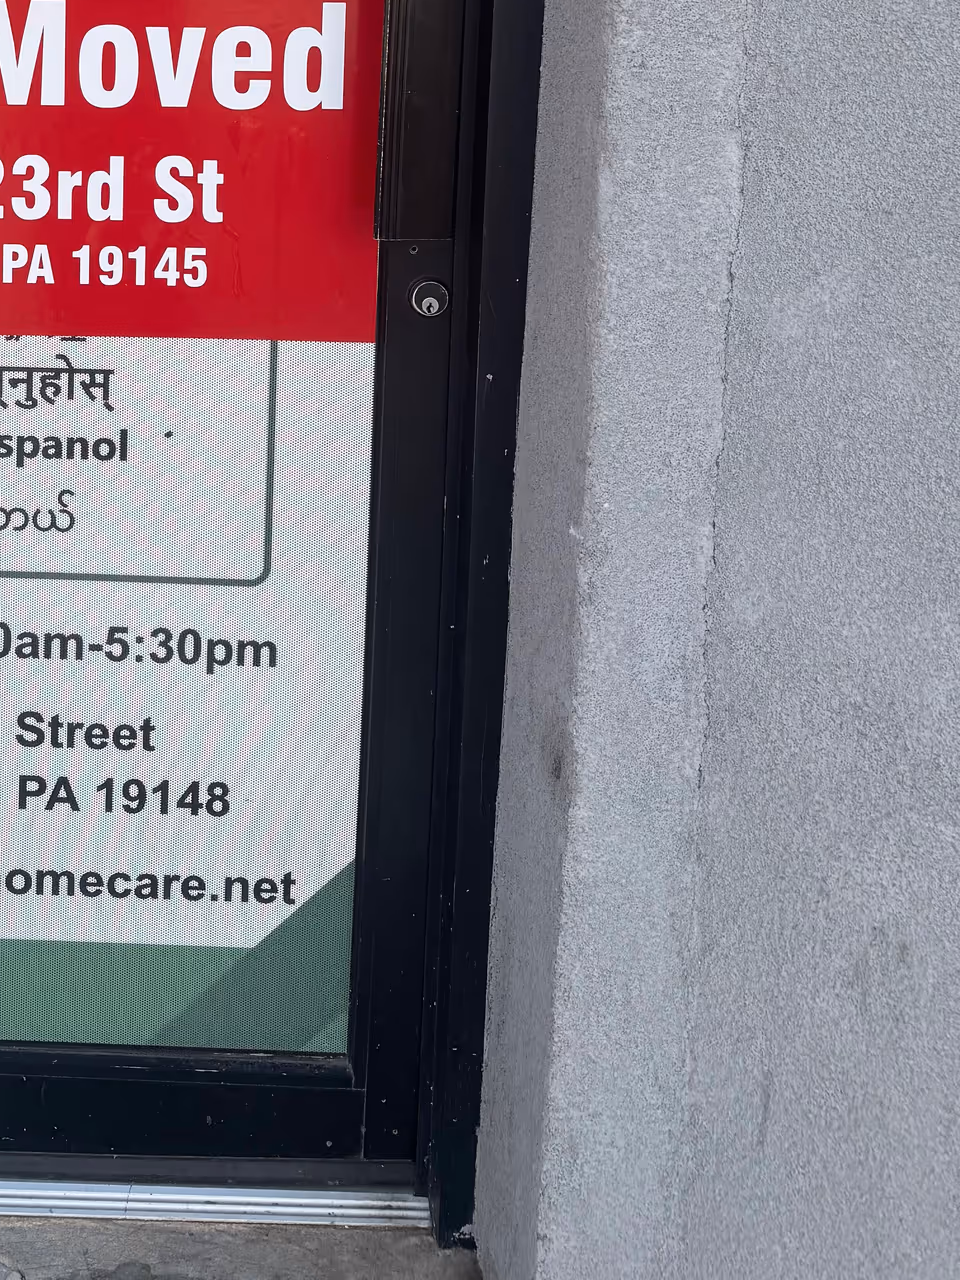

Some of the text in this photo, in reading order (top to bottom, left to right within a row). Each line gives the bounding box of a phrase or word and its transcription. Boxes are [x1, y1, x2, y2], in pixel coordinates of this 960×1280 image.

[154, 156, 224, 222] St
[3, 244, 54, 283] PA
[73, 245, 207, 287] 19145
[16, 711, 155, 752] Street
[18, 775, 79, 811] PA
[97, 778, 230, 817] 19148
